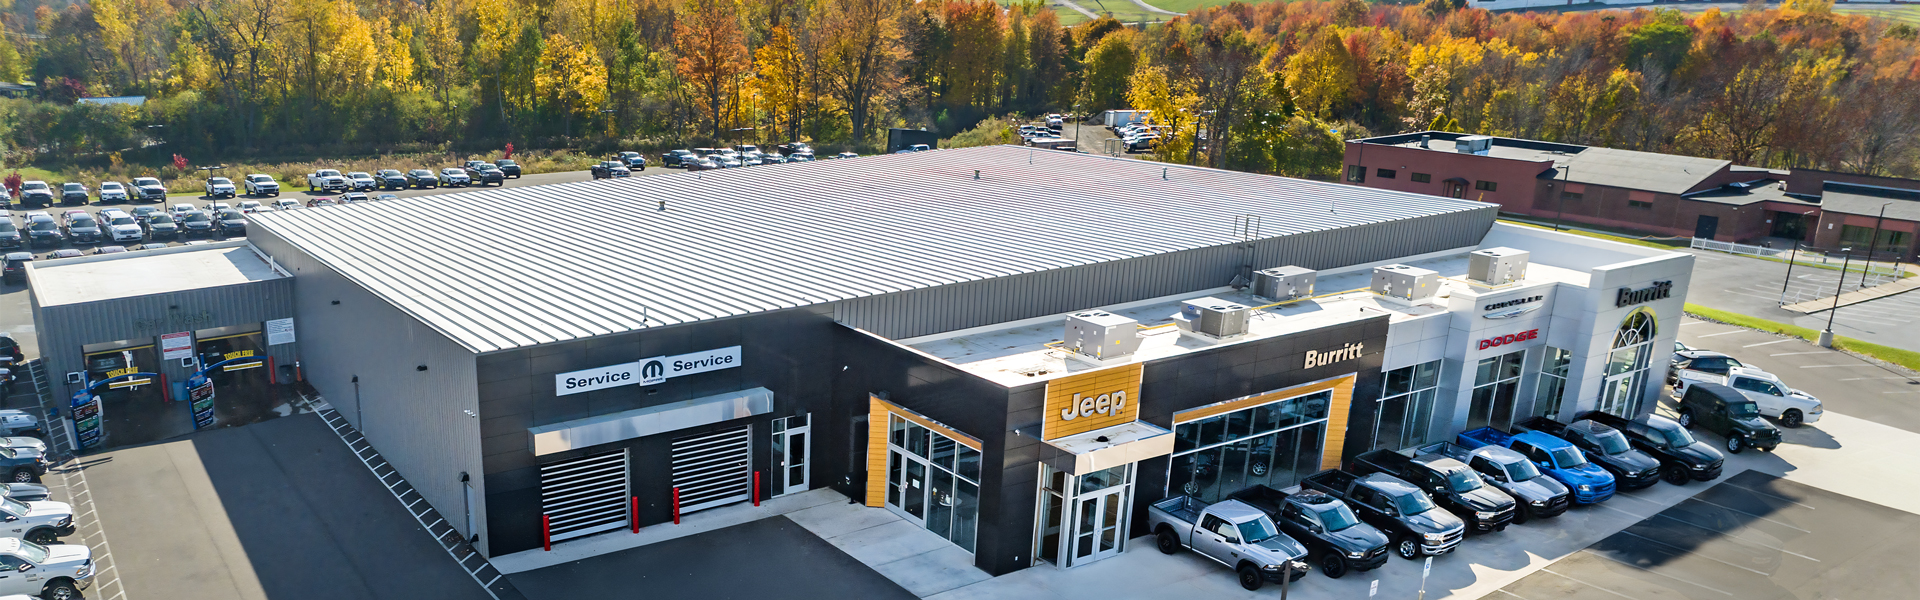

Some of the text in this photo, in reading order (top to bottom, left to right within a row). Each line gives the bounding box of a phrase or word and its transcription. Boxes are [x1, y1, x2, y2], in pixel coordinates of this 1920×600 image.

[1484, 295, 1543, 310] CHRYSLER
[1616, 280, 1672, 308] Burritt
[1479, 329, 1539, 350] DODGE
[224, 351, 241, 360] TOUCH
[673, 355, 733, 372] Service
[1304, 342, 1364, 369] Burritt
[106, 368, 125, 378] TOUCH
[566, 371, 630, 389] Service
[1062, 390, 1127, 420] Jeep
